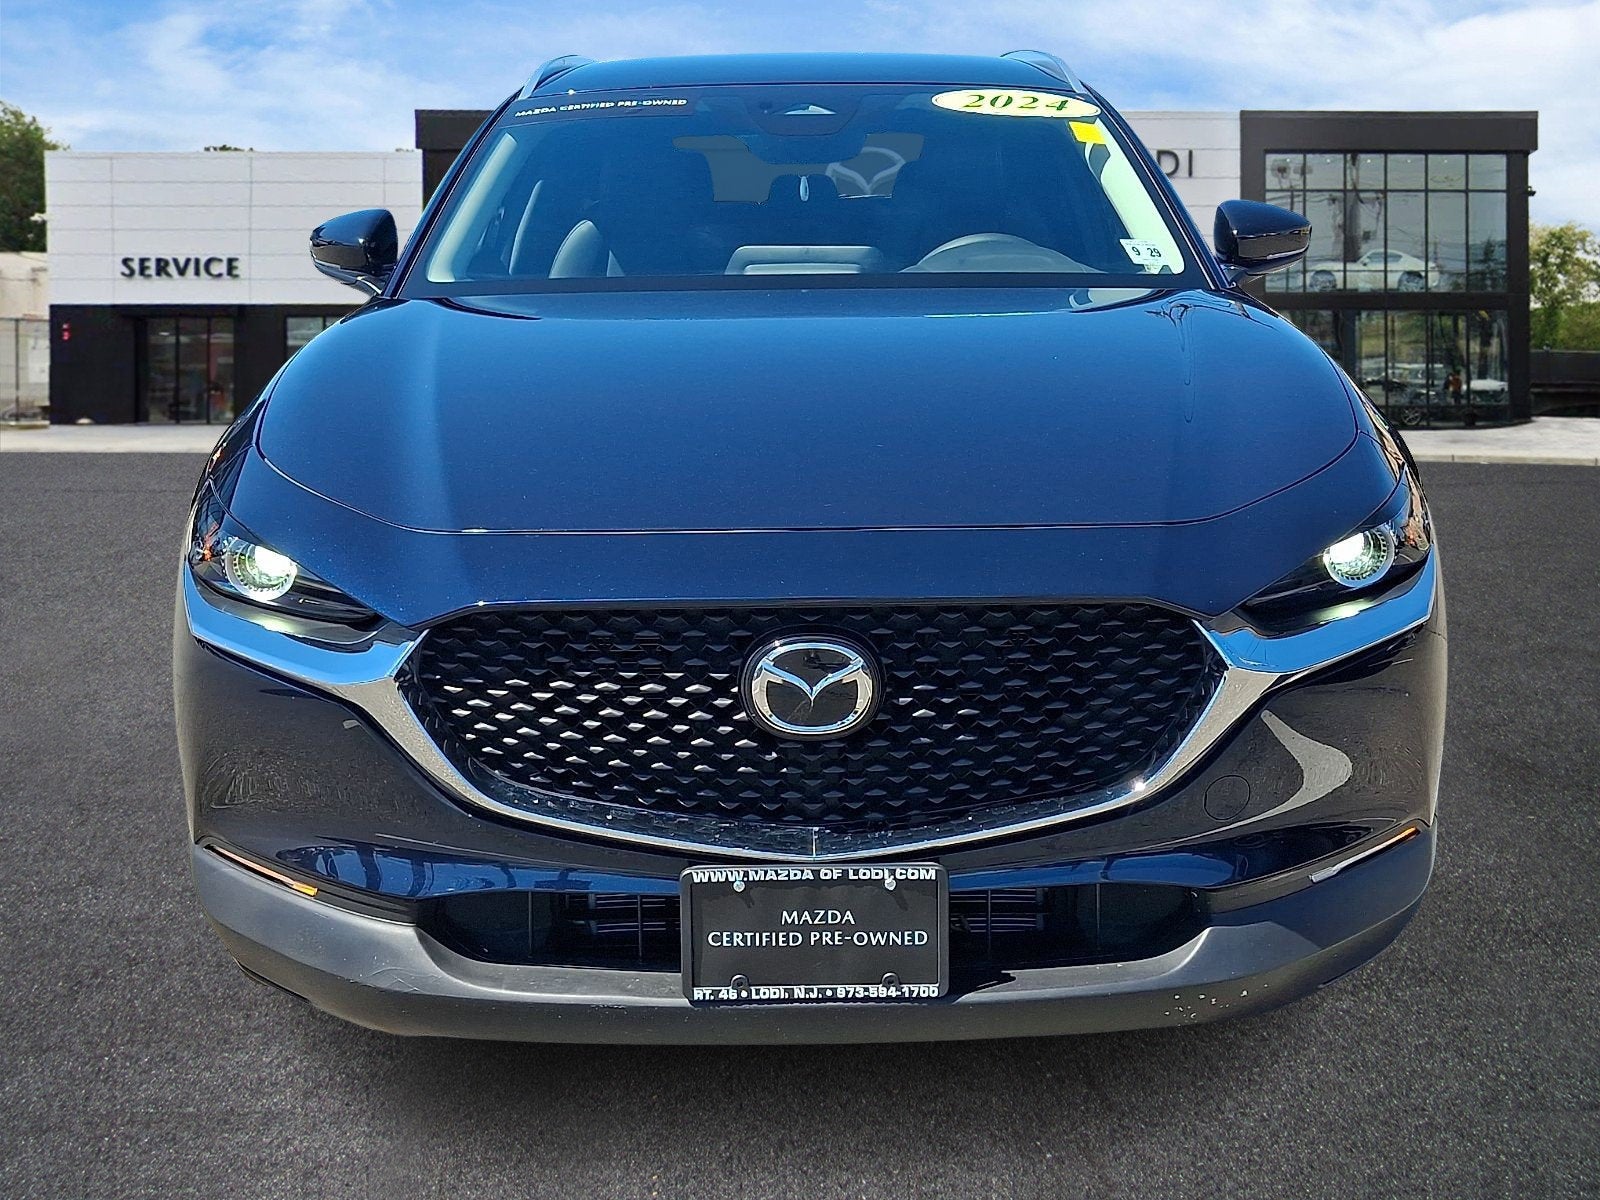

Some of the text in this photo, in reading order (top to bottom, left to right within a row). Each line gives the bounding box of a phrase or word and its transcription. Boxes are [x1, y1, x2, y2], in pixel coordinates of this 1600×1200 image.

[515, 98, 688, 117] MAZDA CERTIFIED PRE-OWNED
[963, 94, 1069, 111] 2024
[1132, 246, 1162, 258] 9 29
[120, 257, 240, 278] SERVICE
[692, 868, 936, 883] WWW.MAZDA OF LODI.COM
[781, 910, 855, 925] MAZDA
[707, 930, 928, 947] CERTIFIED PRE-OWNED
[693, 988, 714, 1000] RT.
[718, 988, 738, 1000] 46
[793, 987, 822, 999] N.J.
